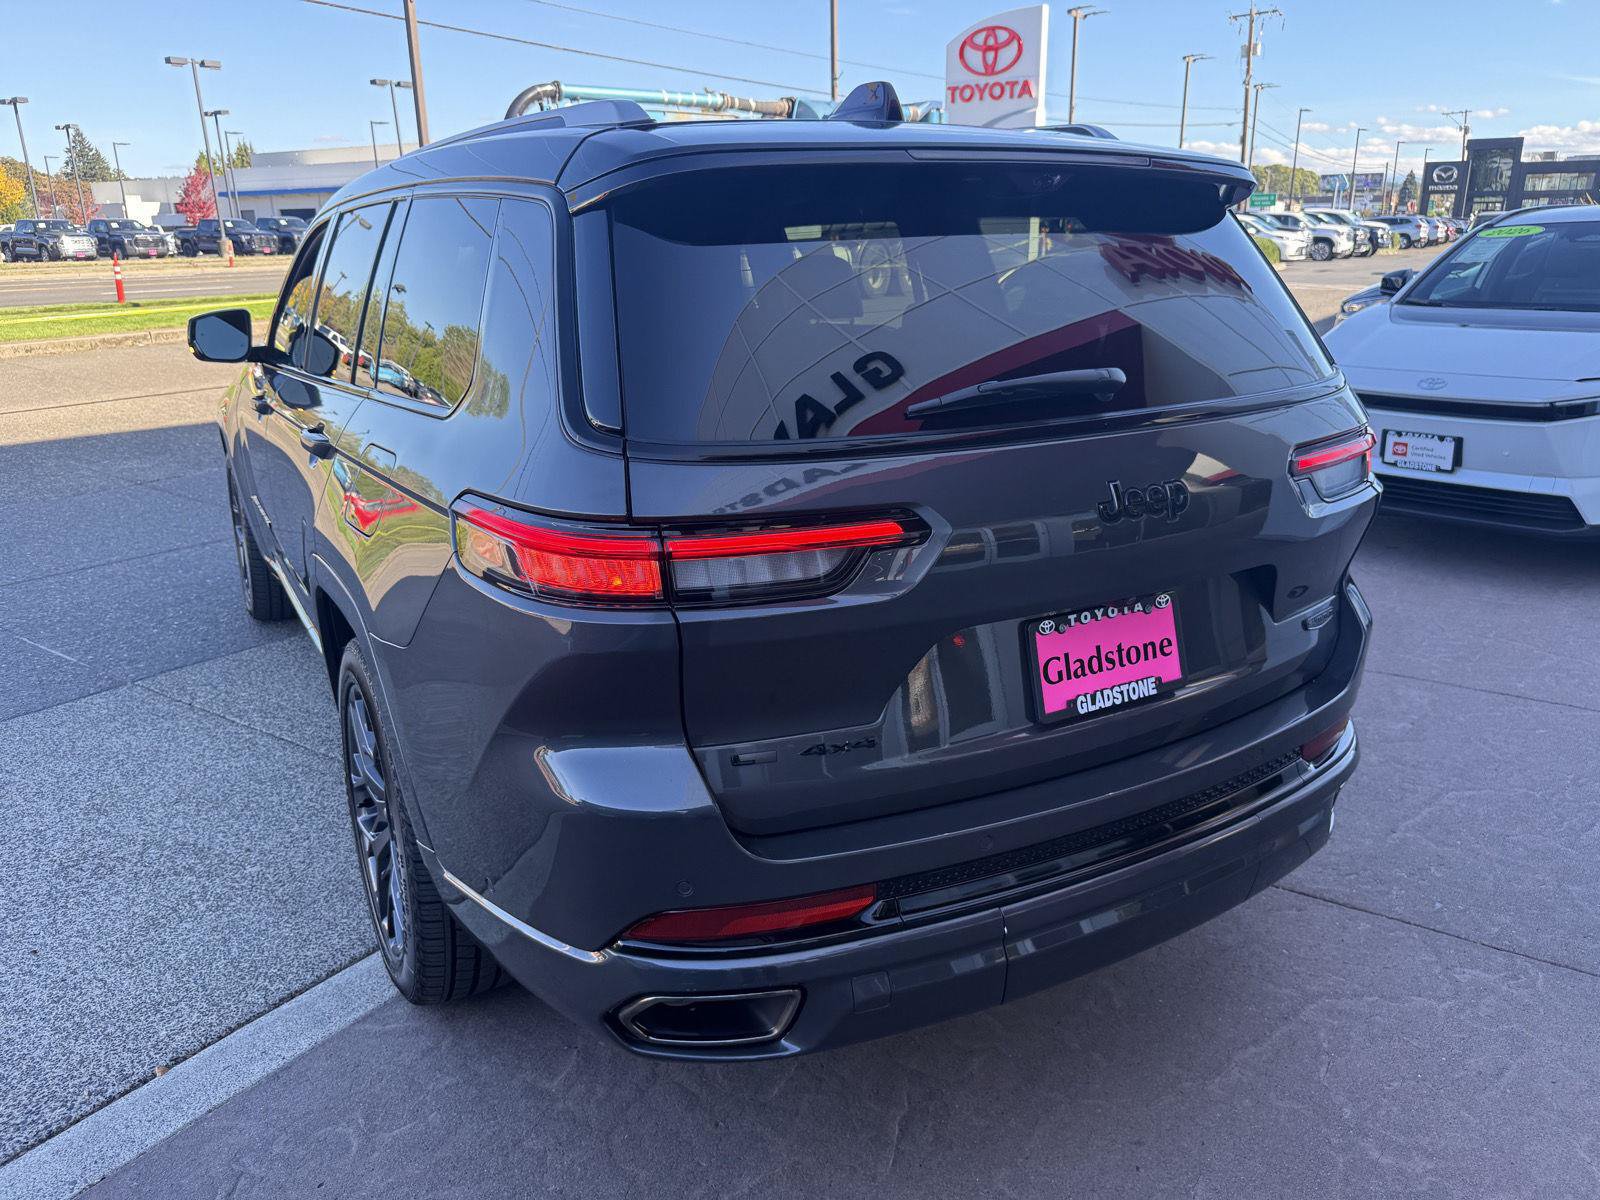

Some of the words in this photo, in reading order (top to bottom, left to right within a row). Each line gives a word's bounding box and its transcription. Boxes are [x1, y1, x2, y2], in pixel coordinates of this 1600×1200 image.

[946, 79, 1035, 104] TOYOTA
[1396, 459, 1438, 472] GLADSTONE
[1096, 478, 1191, 526] Jeep
[1042, 636, 1173, 685] Gladstone
[1076, 676, 1158, 715] GLADSTONE
